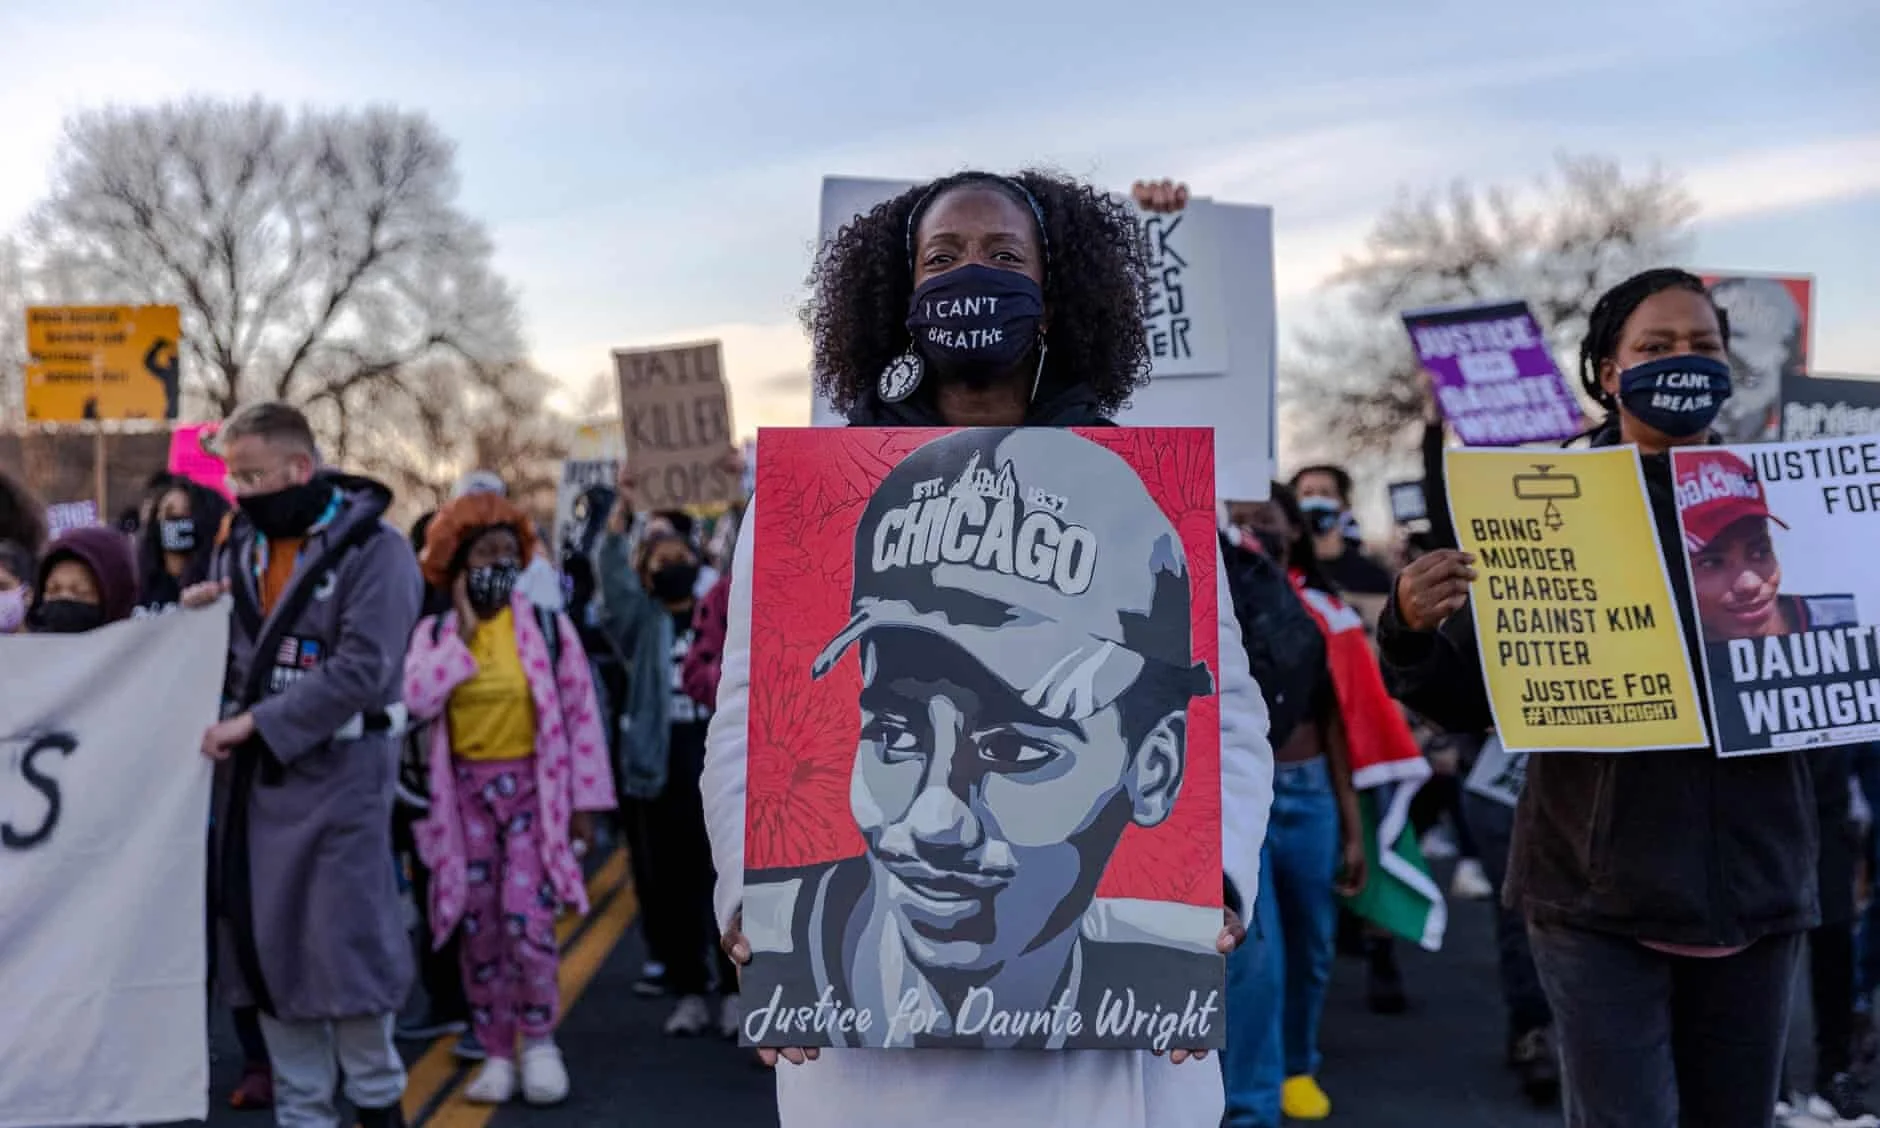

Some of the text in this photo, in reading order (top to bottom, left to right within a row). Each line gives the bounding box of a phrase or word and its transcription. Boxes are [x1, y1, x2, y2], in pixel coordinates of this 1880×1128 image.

[925, 296, 998, 320] I CAN'T
[928, 327, 1003, 349] BREATHE
[626, 347, 717, 389] JAIL
[1743, 443, 1880, 484] JUSTICE
[1471, 518, 1542, 541] BRING
[872, 497, 1097, 595] CHICAGO
[1479, 547, 1577, 571] MURDER
[1488, 575, 1598, 601] CHARGES
[1496, 604, 1656, 633] AGAINST KIM
[1498, 640, 1591, 667] POTTER
[1521, 673, 1672, 703] JUSTICE FOR
[744, 984, 1218, 1050] Justice for Daunte Wright
